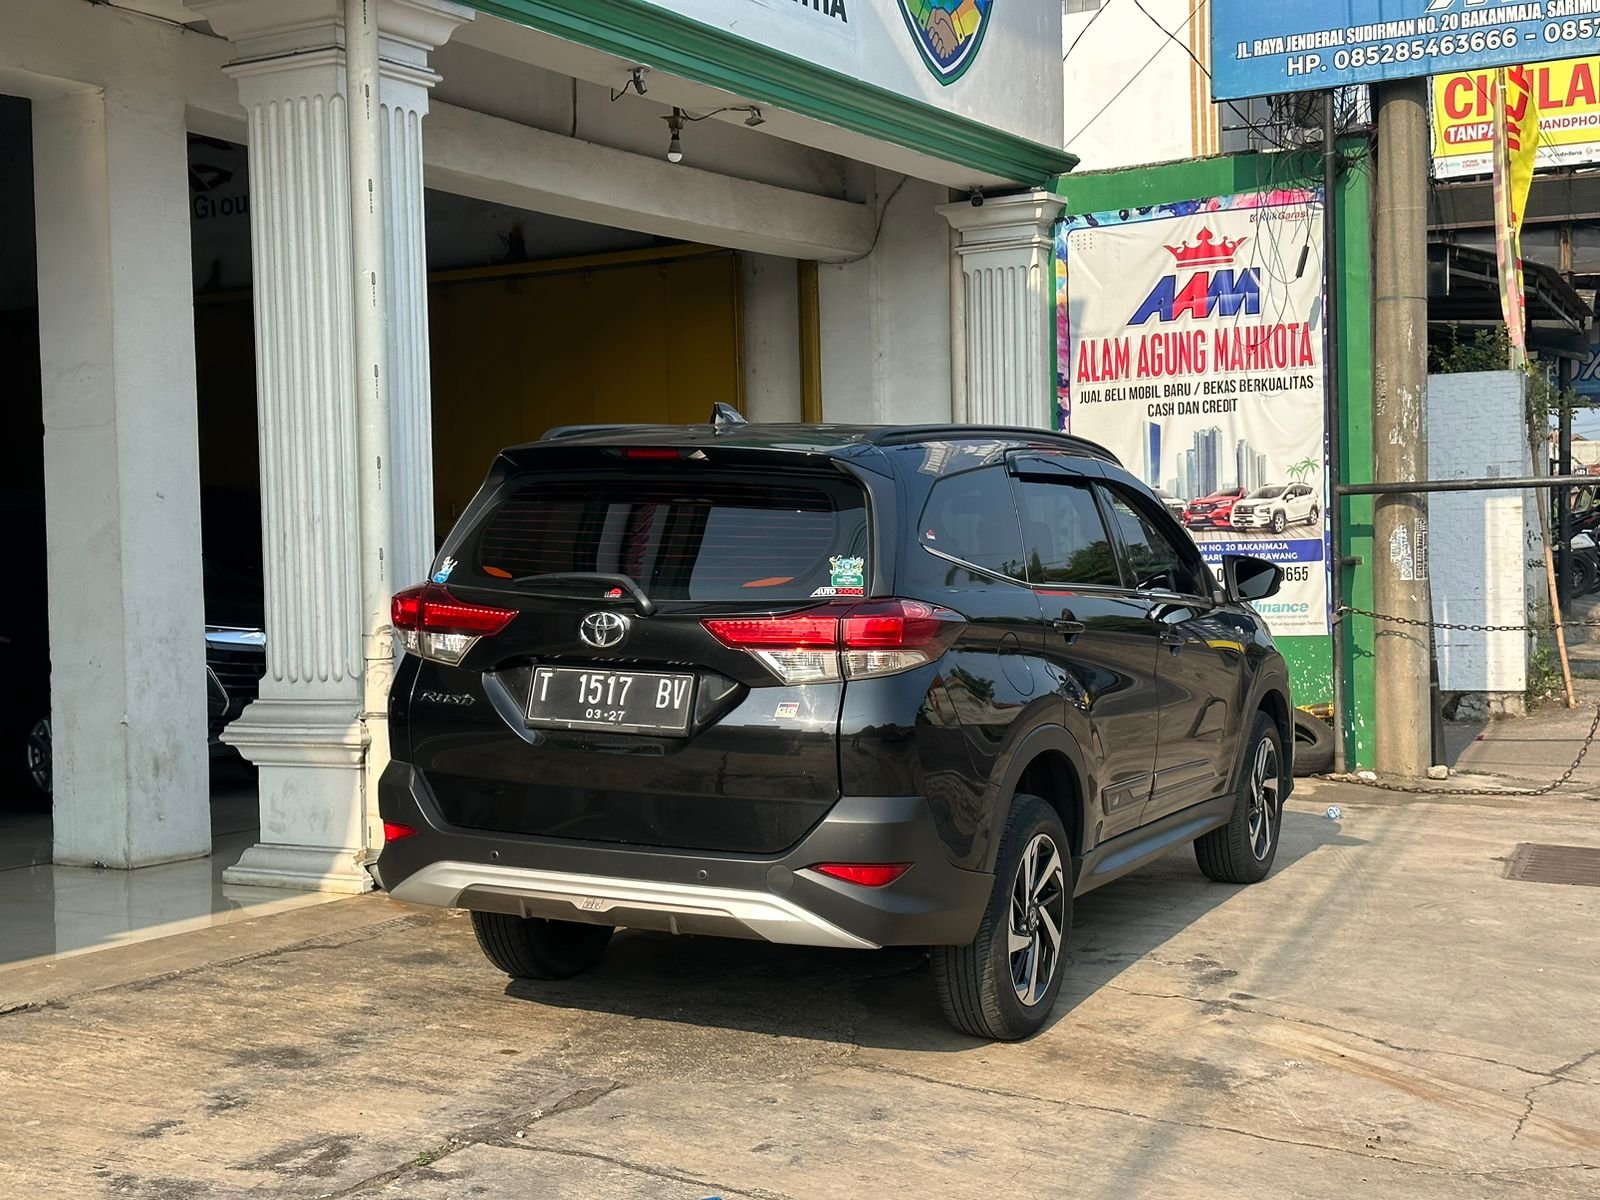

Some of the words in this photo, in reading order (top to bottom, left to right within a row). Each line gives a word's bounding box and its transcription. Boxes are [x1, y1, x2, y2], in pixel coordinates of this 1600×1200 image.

[1236, 42, 1251, 59] JL.
[1254, 37, 1284, 57] RAYA
[1286, 29, 1345, 52] JENDERAL
[1346, 19, 1414, 44] SUDIRMAN
[1416, 17, 1439, 35] NO.
[1441, 14, 1459, 31] 20
[1460, 3, 1545, 28] BAKANMAJA,
[1287, 54, 1327, 76] HP.
[1334, 27, 1517, 71] 085285463666
[1127, 267, 1260, 325] AAM
[1077, 337, 1130, 383] ALAM
[1137, 330, 1206, 379] AGUNG
[1214, 321, 1314, 373] MAHKOTA
[1080, 389, 1102, 404] JUAL
[1105, 387, 1126, 401] BELI
[1129, 385, 1161, 400] MOBIL
[1164, 383, 1191, 397] BARU
[1203, 379, 1236, 394] BEKAS
[1239, 375, 1314, 392] BERKUALITAS
[1147, 402, 1174, 417] CASH
[1178, 401, 1200, 415] DAN
[1202, 399, 1238, 414] CREDIT
[1209, 544, 1224, 552] NO.
[1237, 542, 1288, 551] BAKANMAJA
[811, 587, 836, 596] AUTO
[838, 587, 864, 596] 2000
[541, 672, 553, 701] T
[578, 674, 633, 706] 1517
[655, 678, 688, 709] BV
